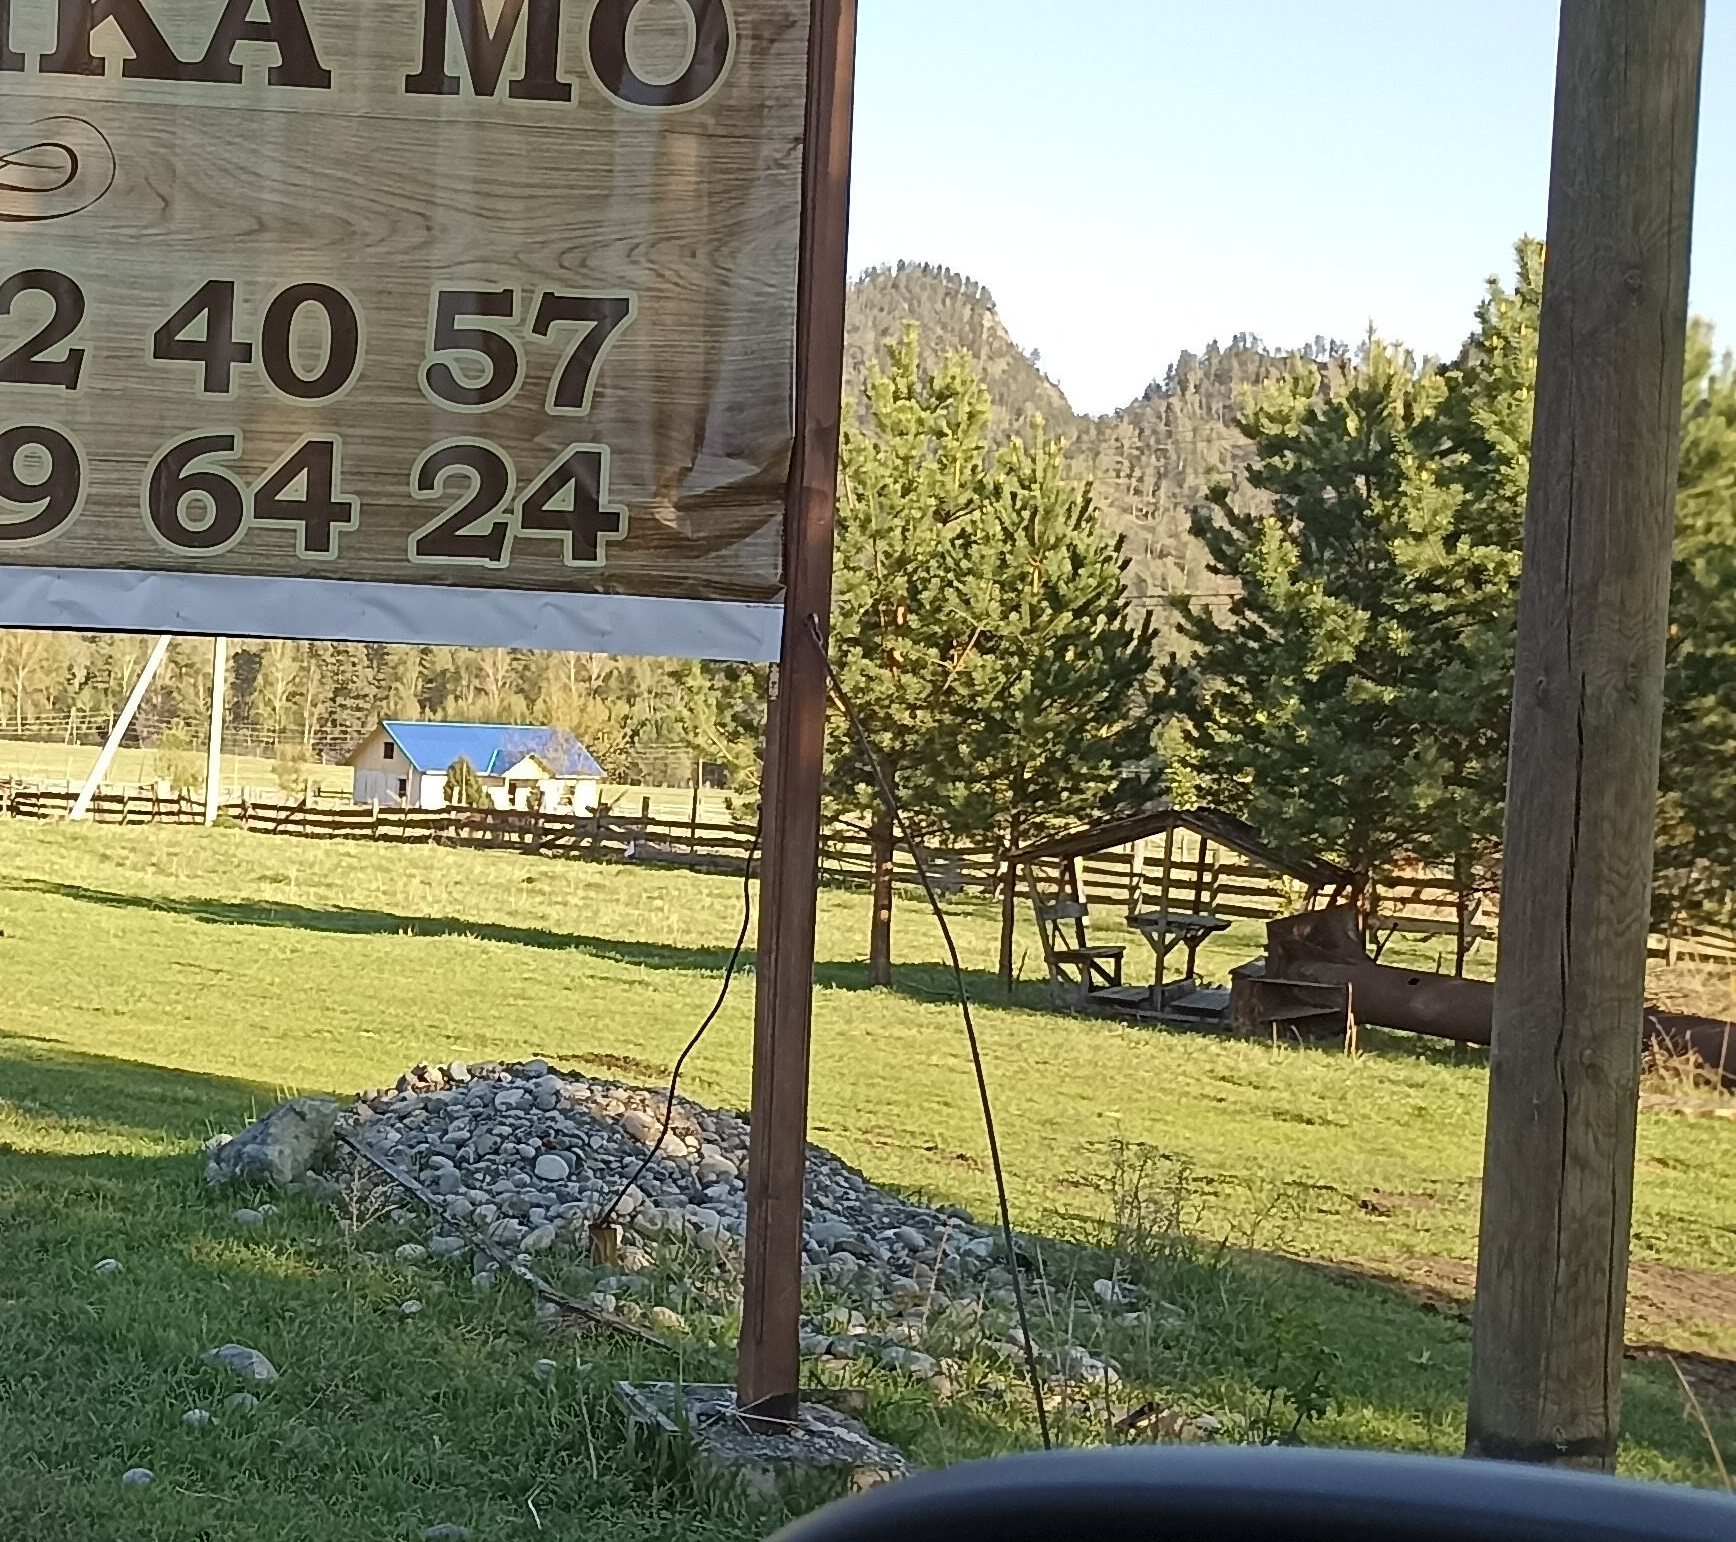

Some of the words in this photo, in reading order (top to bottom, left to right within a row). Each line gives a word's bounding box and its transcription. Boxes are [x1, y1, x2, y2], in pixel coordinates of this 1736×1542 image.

[152, 279, 359, 399] 40
[424, 287, 631, 410] 57
[148, 433, 353, 553] 64
[414, 444, 622, 563] 24
